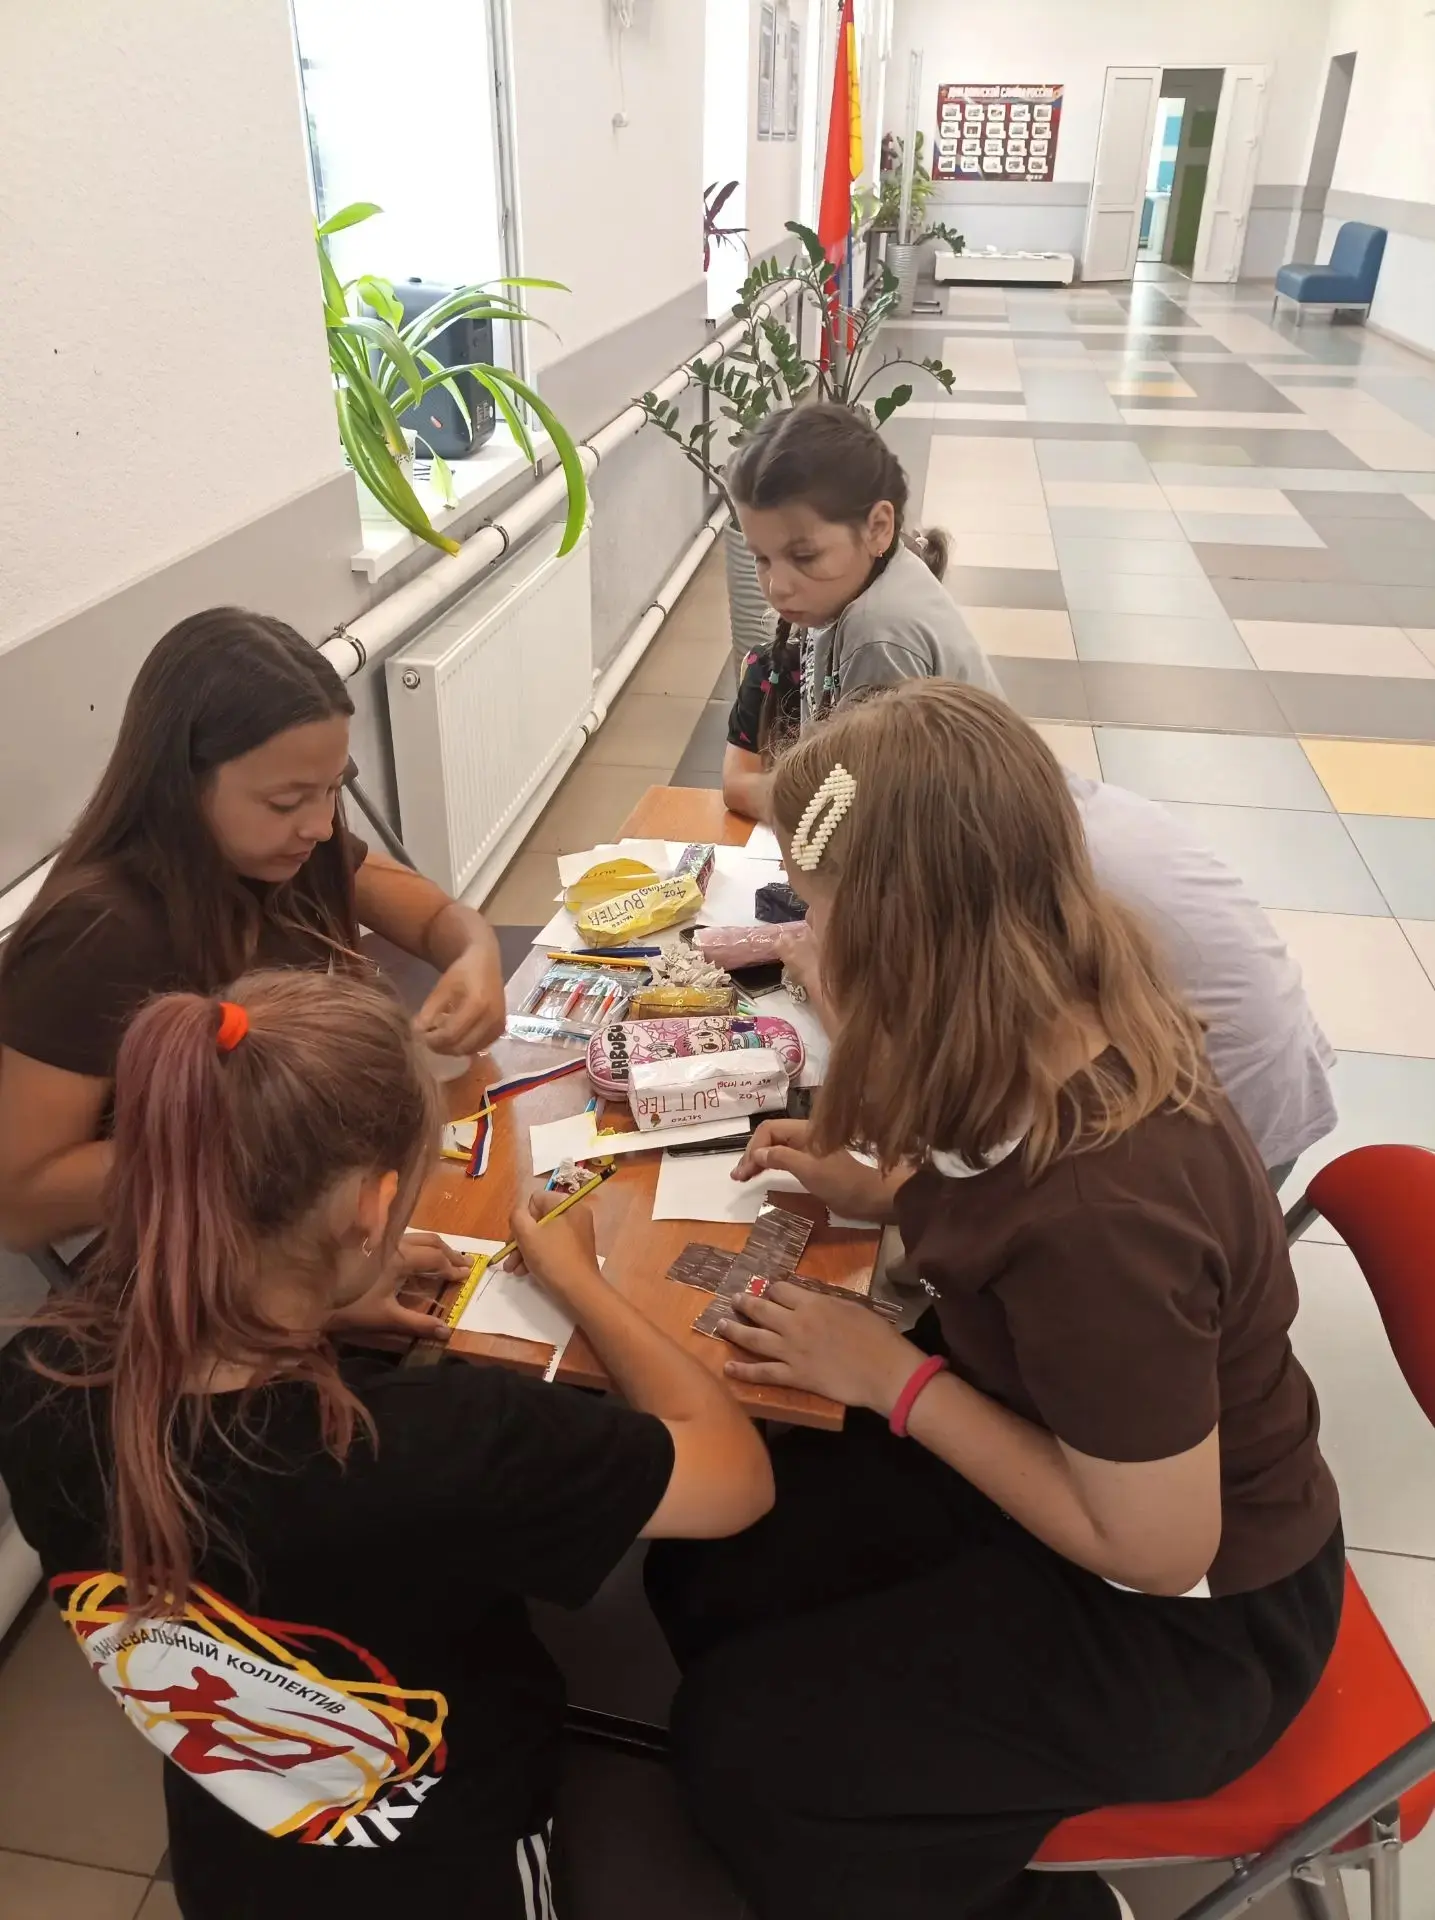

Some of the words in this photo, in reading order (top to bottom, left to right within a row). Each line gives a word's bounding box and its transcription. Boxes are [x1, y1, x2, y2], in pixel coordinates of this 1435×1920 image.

[587, 892, 645, 926] BUTTER
[607, 1024, 630, 1080] LABUBU
[638, 1088, 720, 1115] BUTTER
[756, 1091, 766, 1108] 4
[226, 1653, 347, 1716] КОЛЛЕКТИВ
